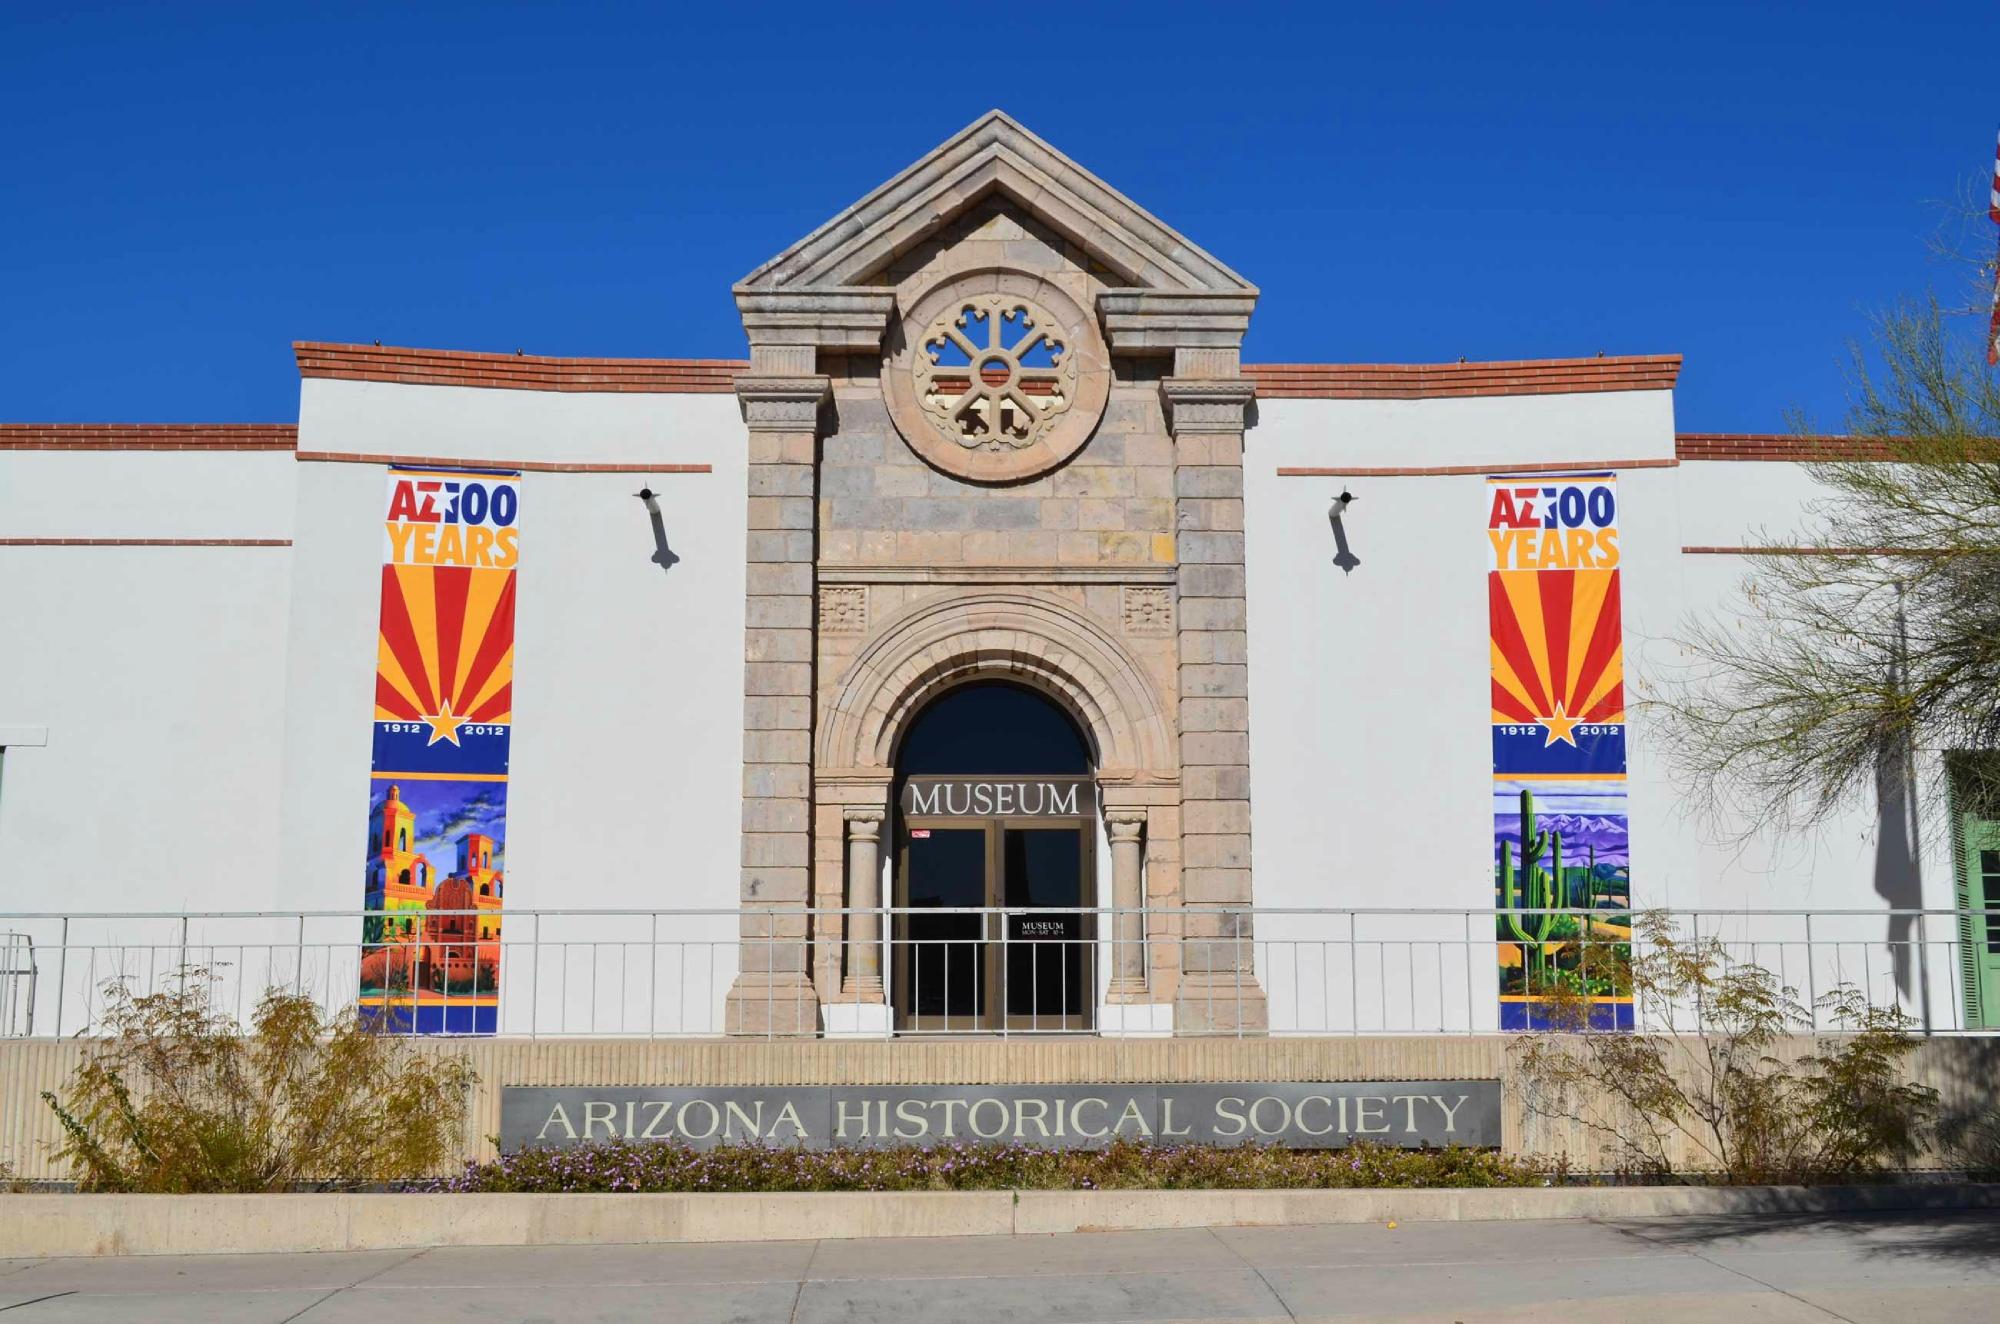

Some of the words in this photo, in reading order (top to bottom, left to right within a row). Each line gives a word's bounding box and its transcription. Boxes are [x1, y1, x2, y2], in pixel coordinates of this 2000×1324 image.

[385, 522, 519, 568] YEARS
[1487, 528, 1620, 569] YEARS
[383, 723, 420, 734] 1912
[464, 725, 504, 736] 2012
[1500, 726, 1537, 736] 1912
[1579, 726, 1619, 736] 2012
[909, 783, 1080, 815] MUSEUM
[1022, 922, 1064, 930] MUSEUM
[535, 1100, 809, 1139] ARIZONA
[835, 1098, 1192, 1138] HISTORICAL
[1213, 1095, 1469, 1136] SOCIETY
